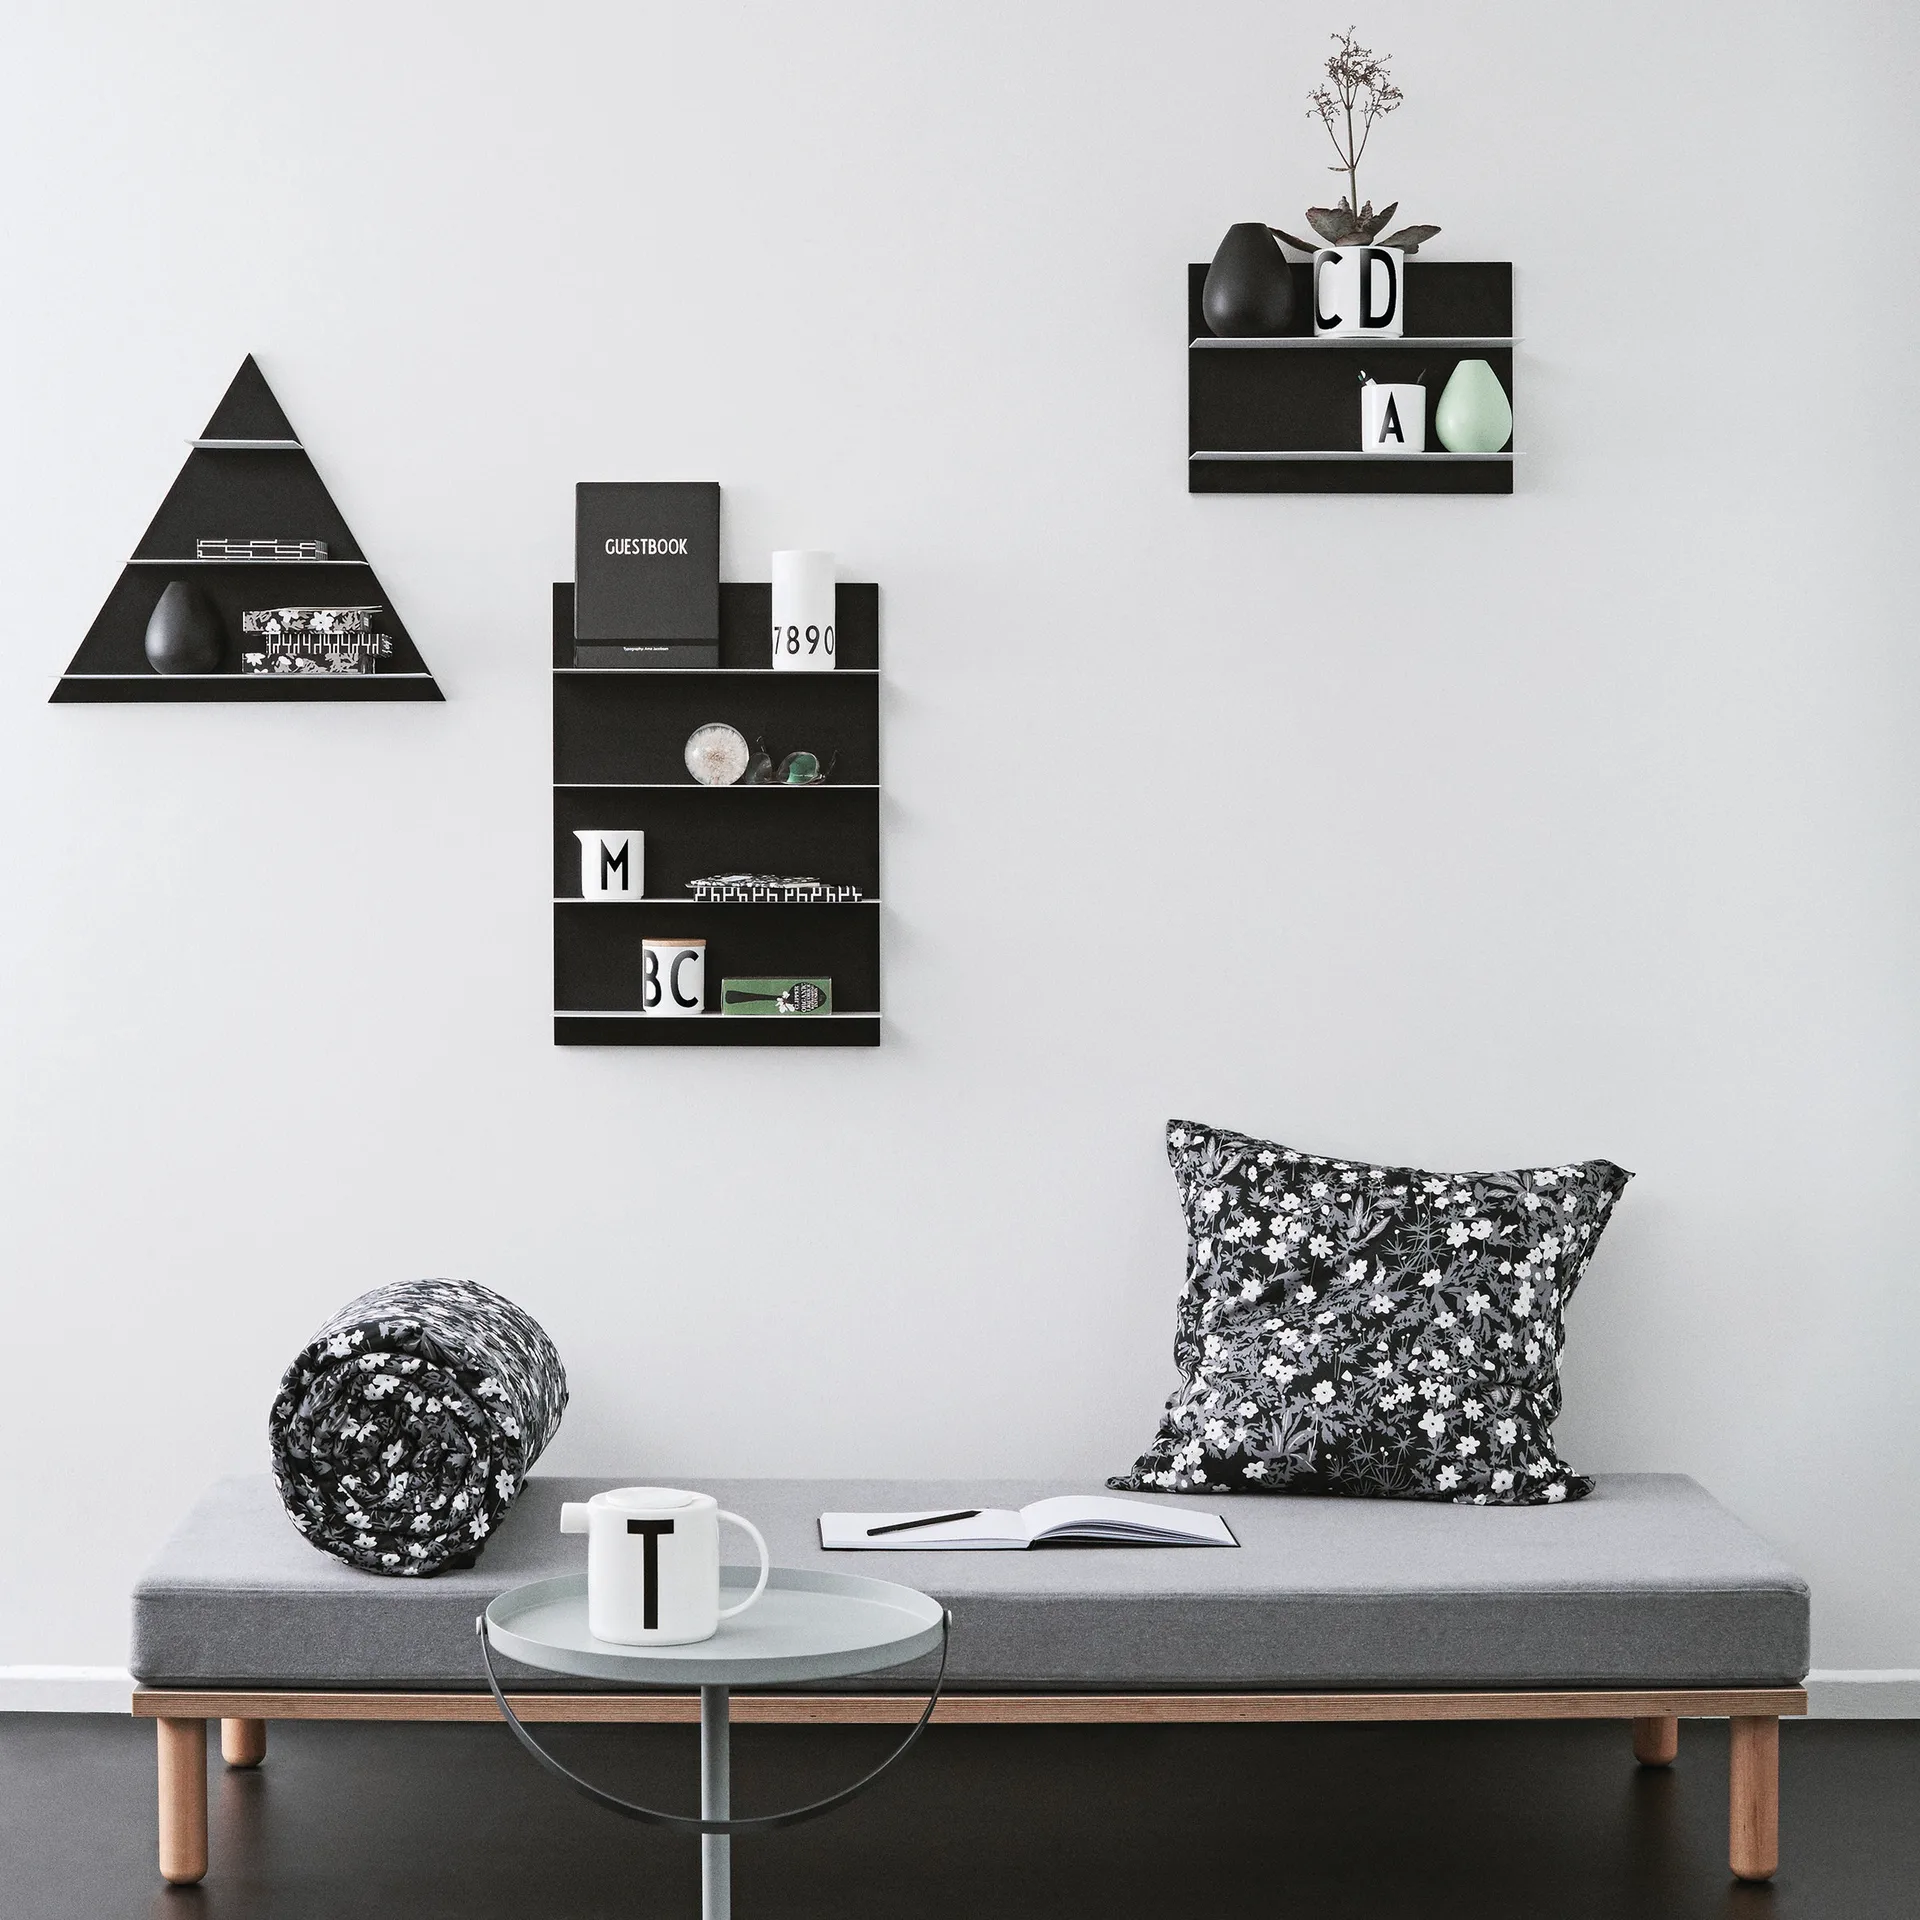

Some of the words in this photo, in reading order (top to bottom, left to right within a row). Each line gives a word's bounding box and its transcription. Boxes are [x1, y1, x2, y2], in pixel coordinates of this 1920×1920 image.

[1378, 391, 1405, 443] A
[605, 538, 688, 555] GUESTBOOK
[774, 625, 835, 655] 7890
[600, 838, 629, 891] M
[627, 1519, 675, 1630] T
